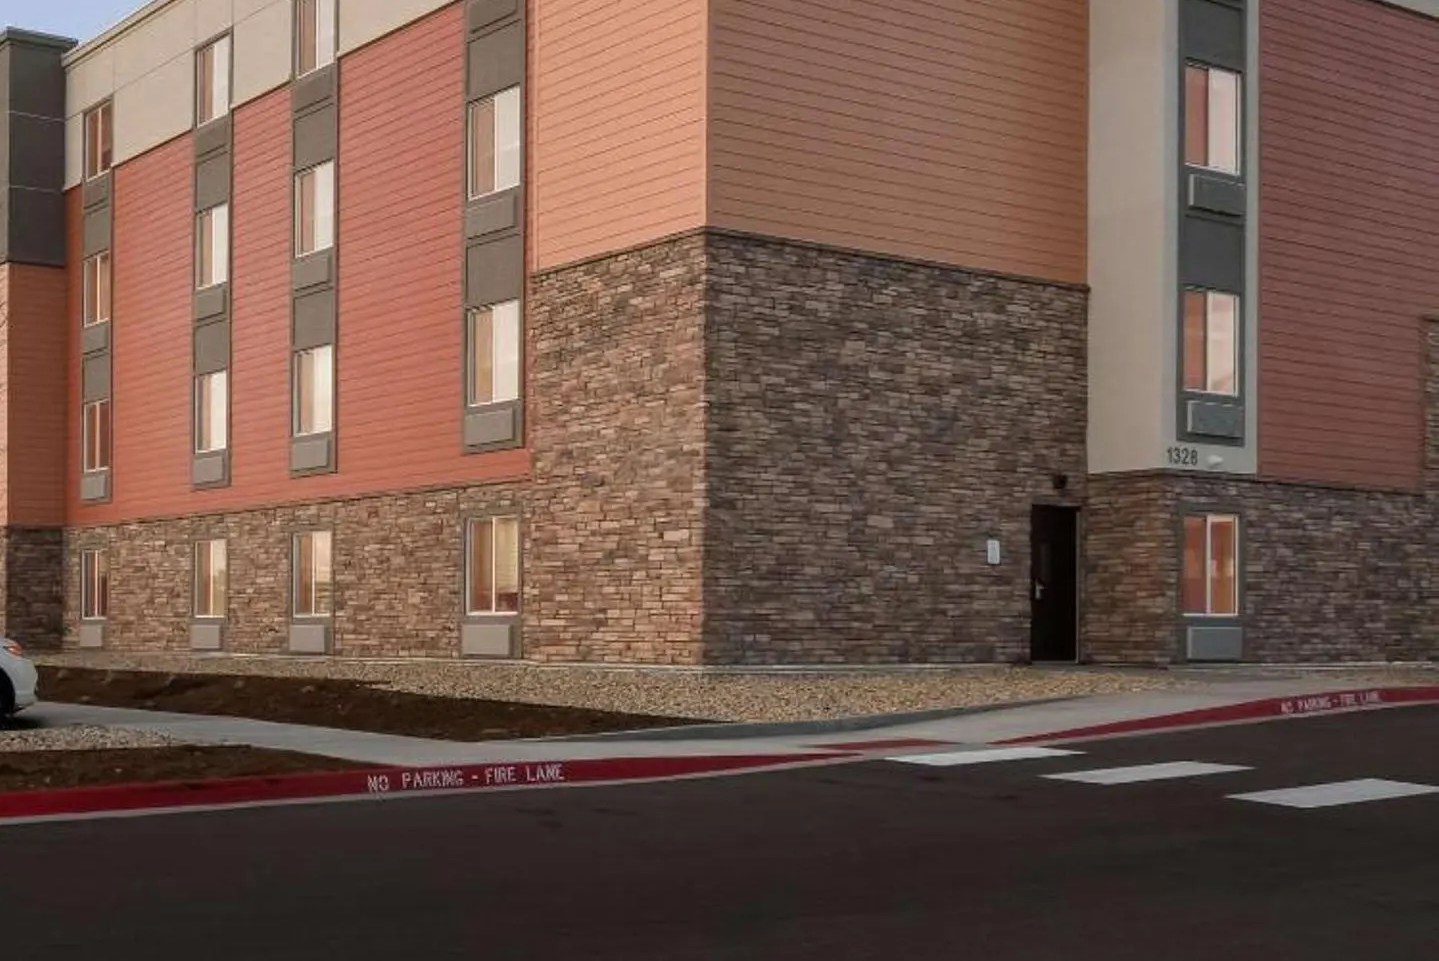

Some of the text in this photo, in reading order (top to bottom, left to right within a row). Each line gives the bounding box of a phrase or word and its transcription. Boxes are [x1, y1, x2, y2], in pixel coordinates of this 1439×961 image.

[1166, 447, 1198, 466] 1328
[368, 775, 389, 791] NO
[402, 771, 464, 789] PARKING
[485, 767, 515, 784] FIRE
[526, 764, 564, 781] LANE
